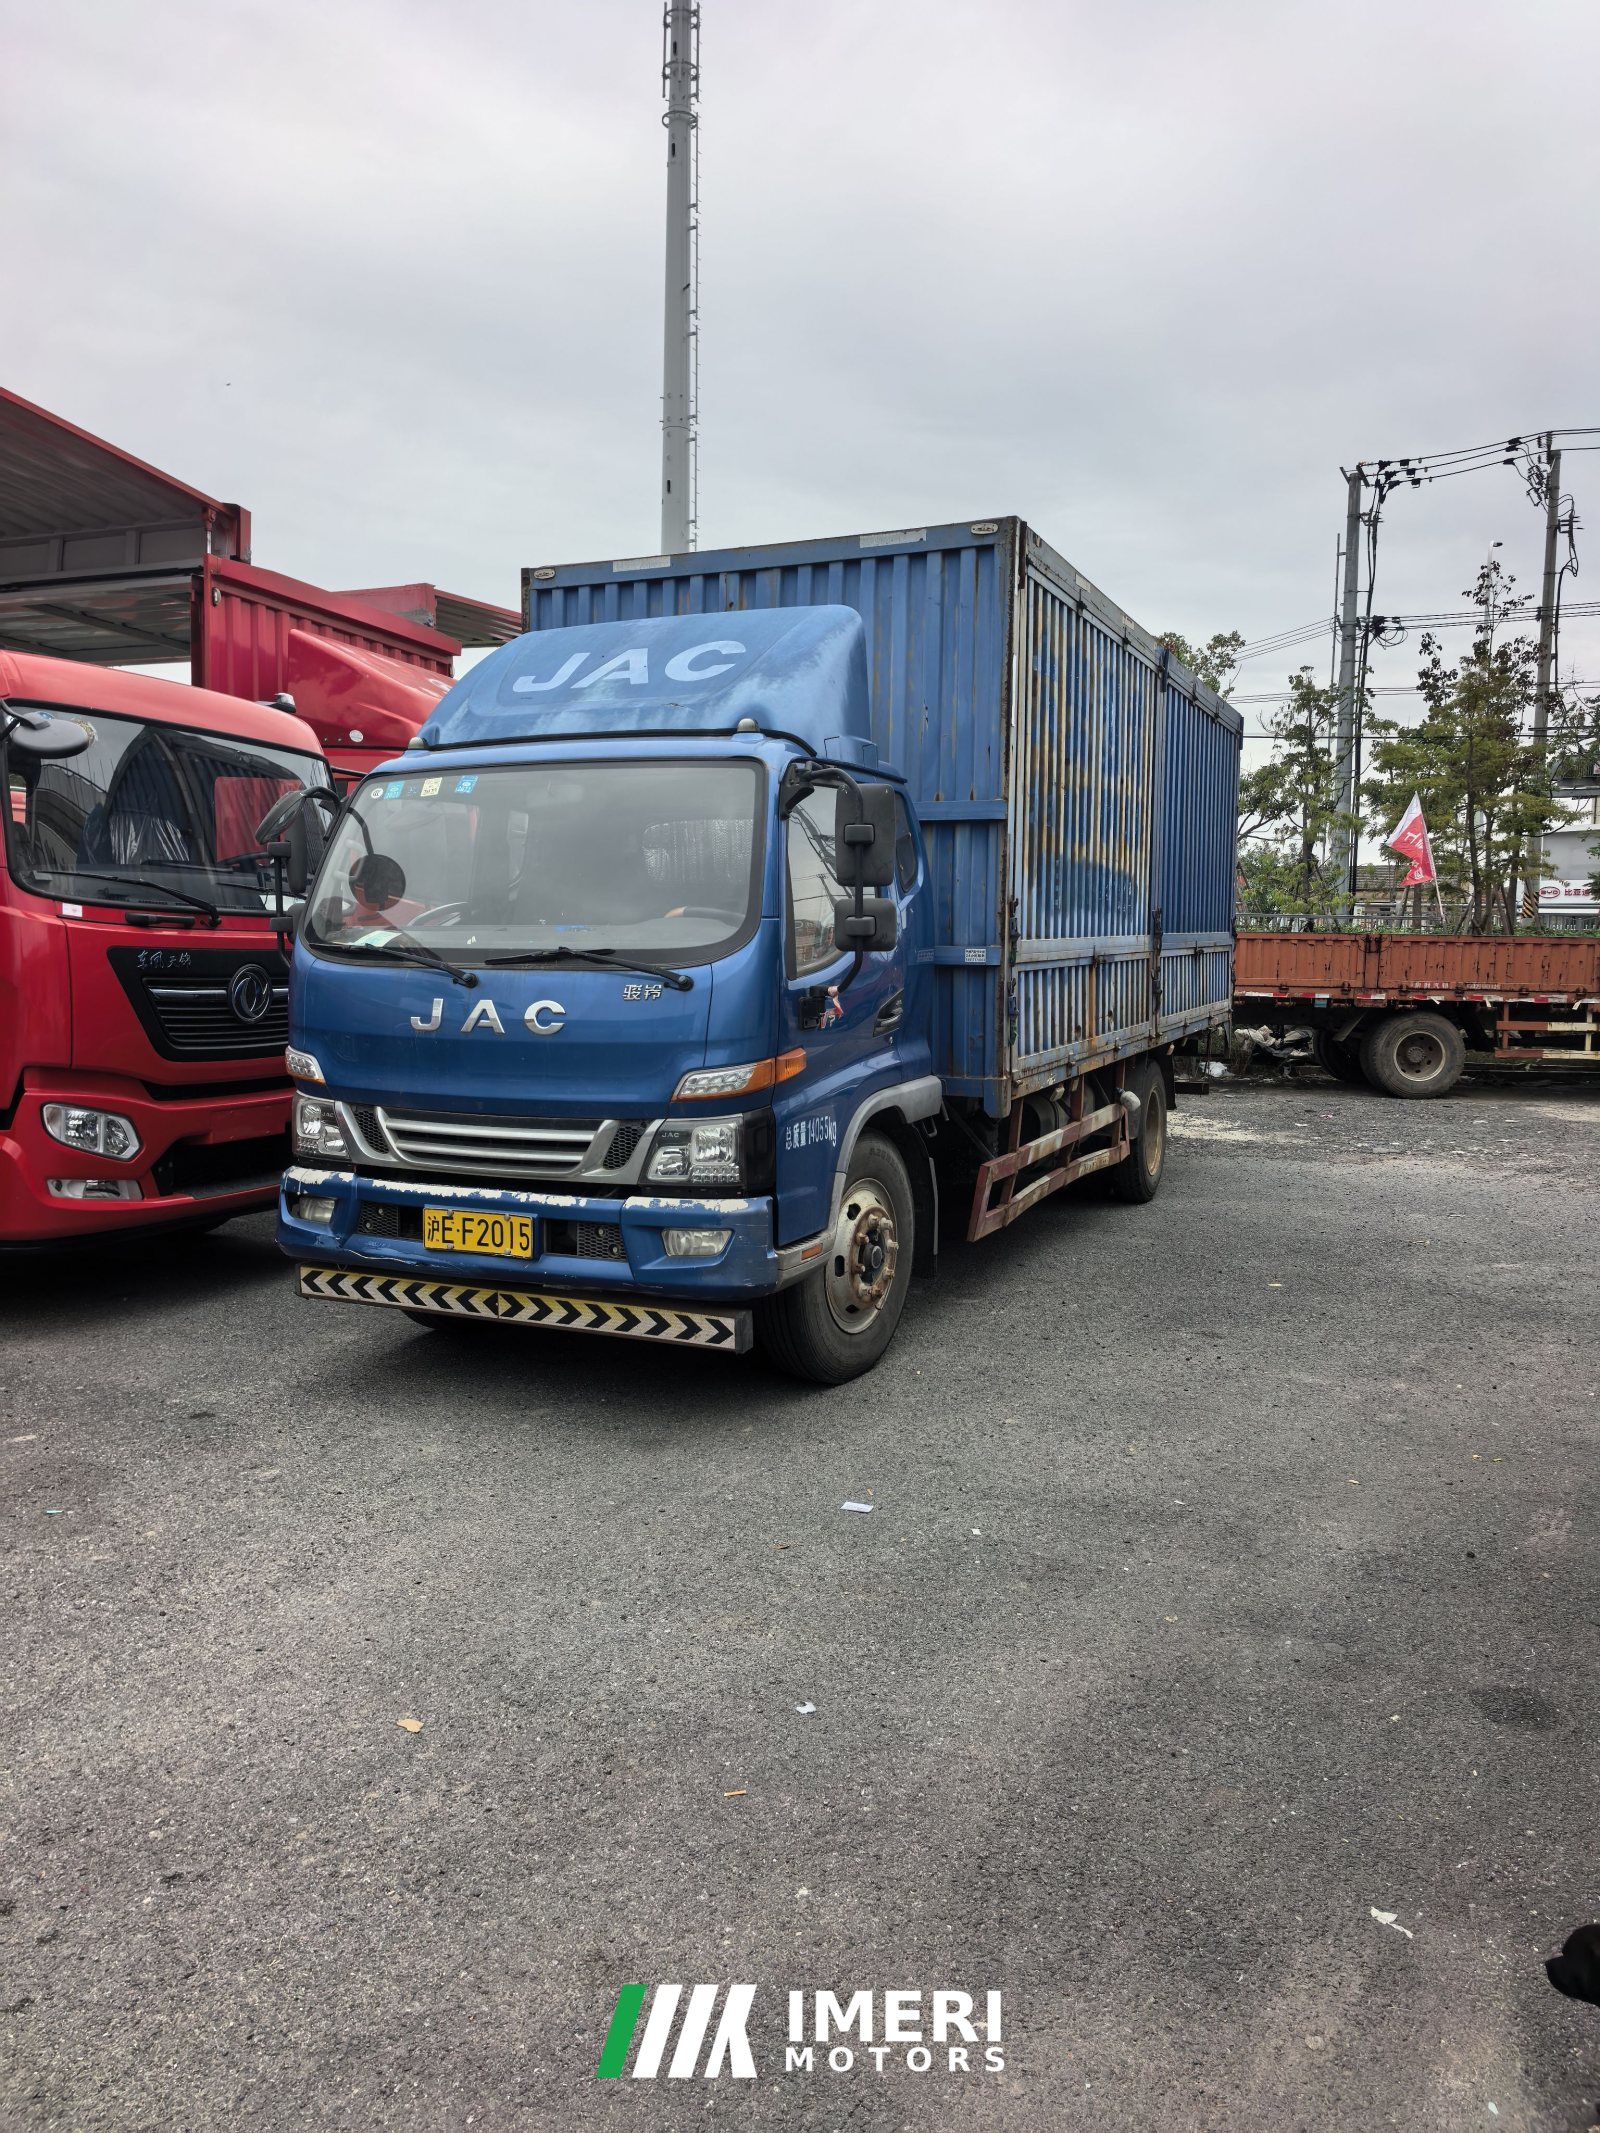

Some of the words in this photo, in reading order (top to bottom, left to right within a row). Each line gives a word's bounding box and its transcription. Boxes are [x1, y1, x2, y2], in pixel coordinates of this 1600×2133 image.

[512, 640, 747, 693] JAC
[622, 984, 662, 1000] 骏铃
[410, 997, 566, 1035] JAC
